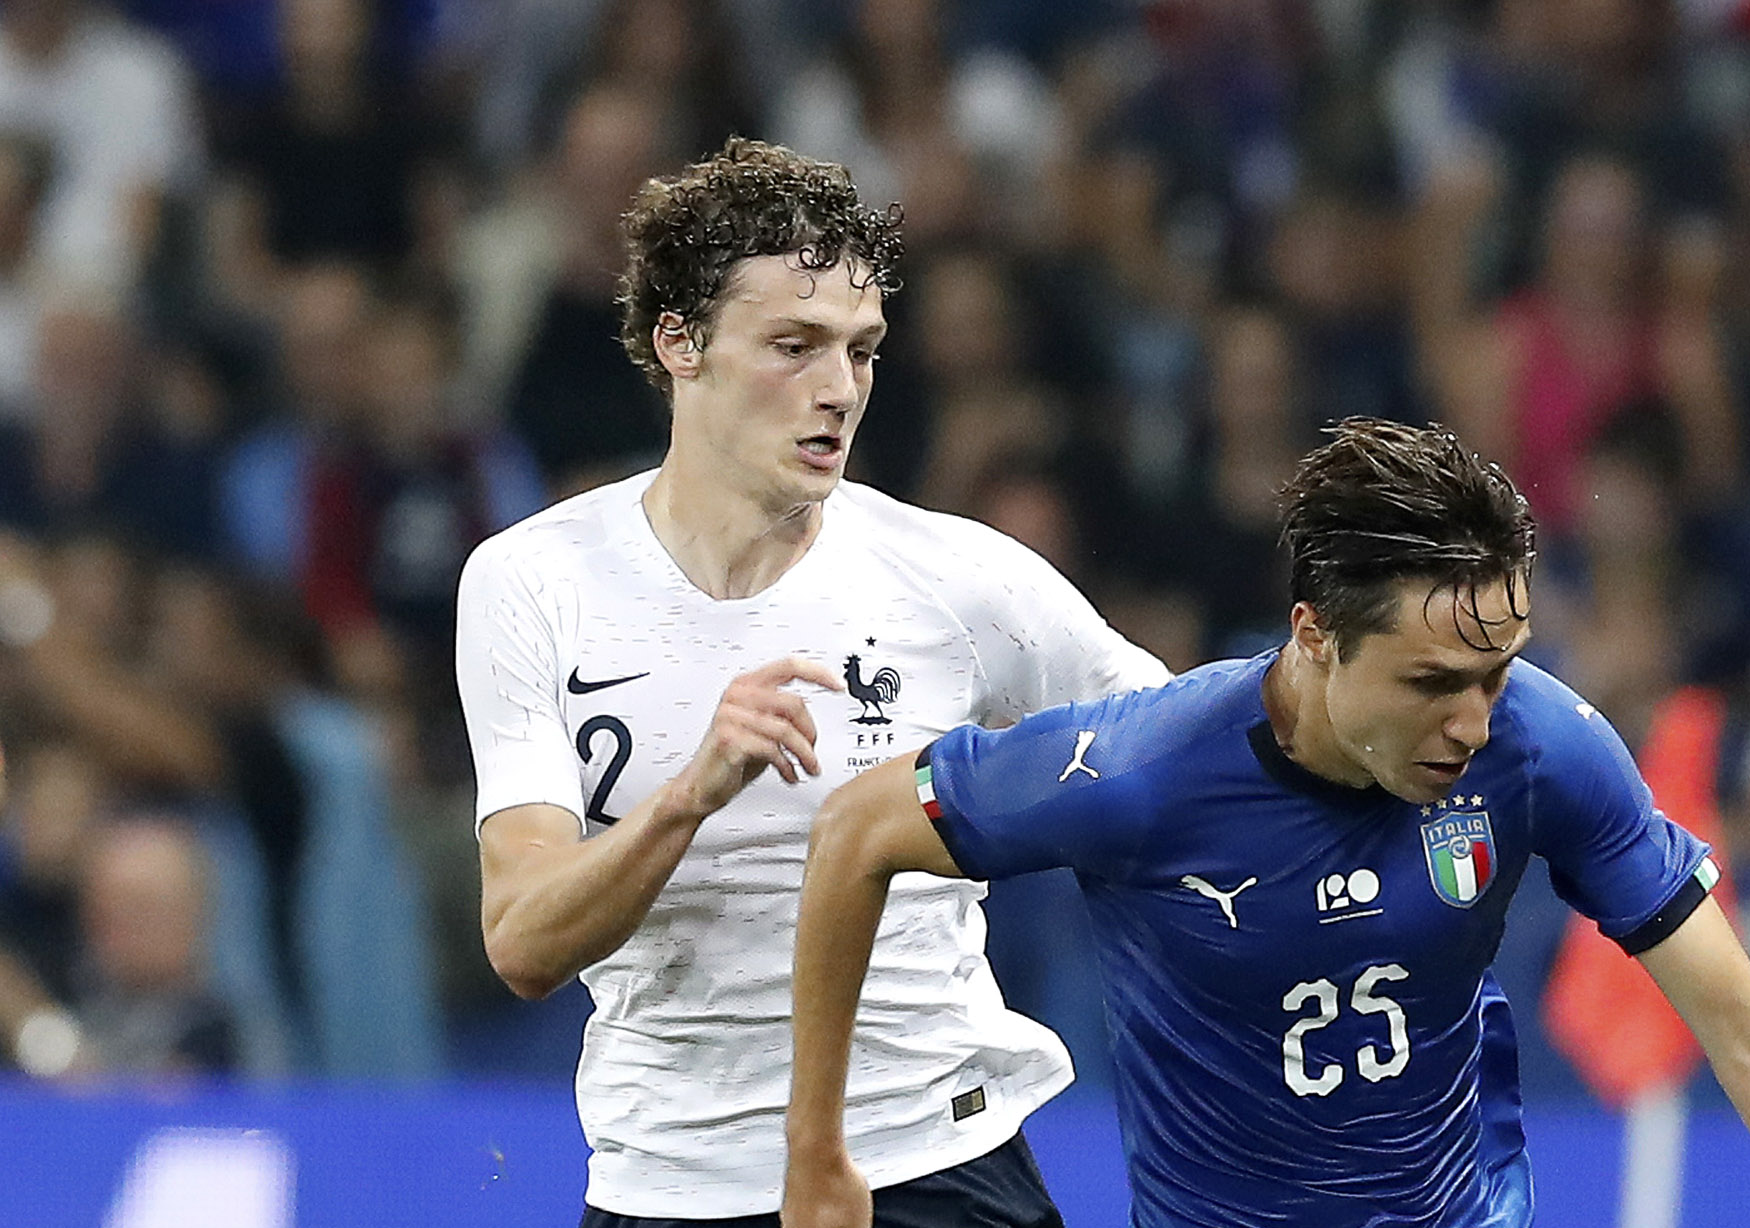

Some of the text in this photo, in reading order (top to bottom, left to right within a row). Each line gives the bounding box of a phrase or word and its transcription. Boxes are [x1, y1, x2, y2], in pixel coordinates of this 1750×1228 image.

[576, 714, 633, 826] 2
[1428, 818, 1486, 843] ITALIA
[1282, 963, 1411, 1097] 25
